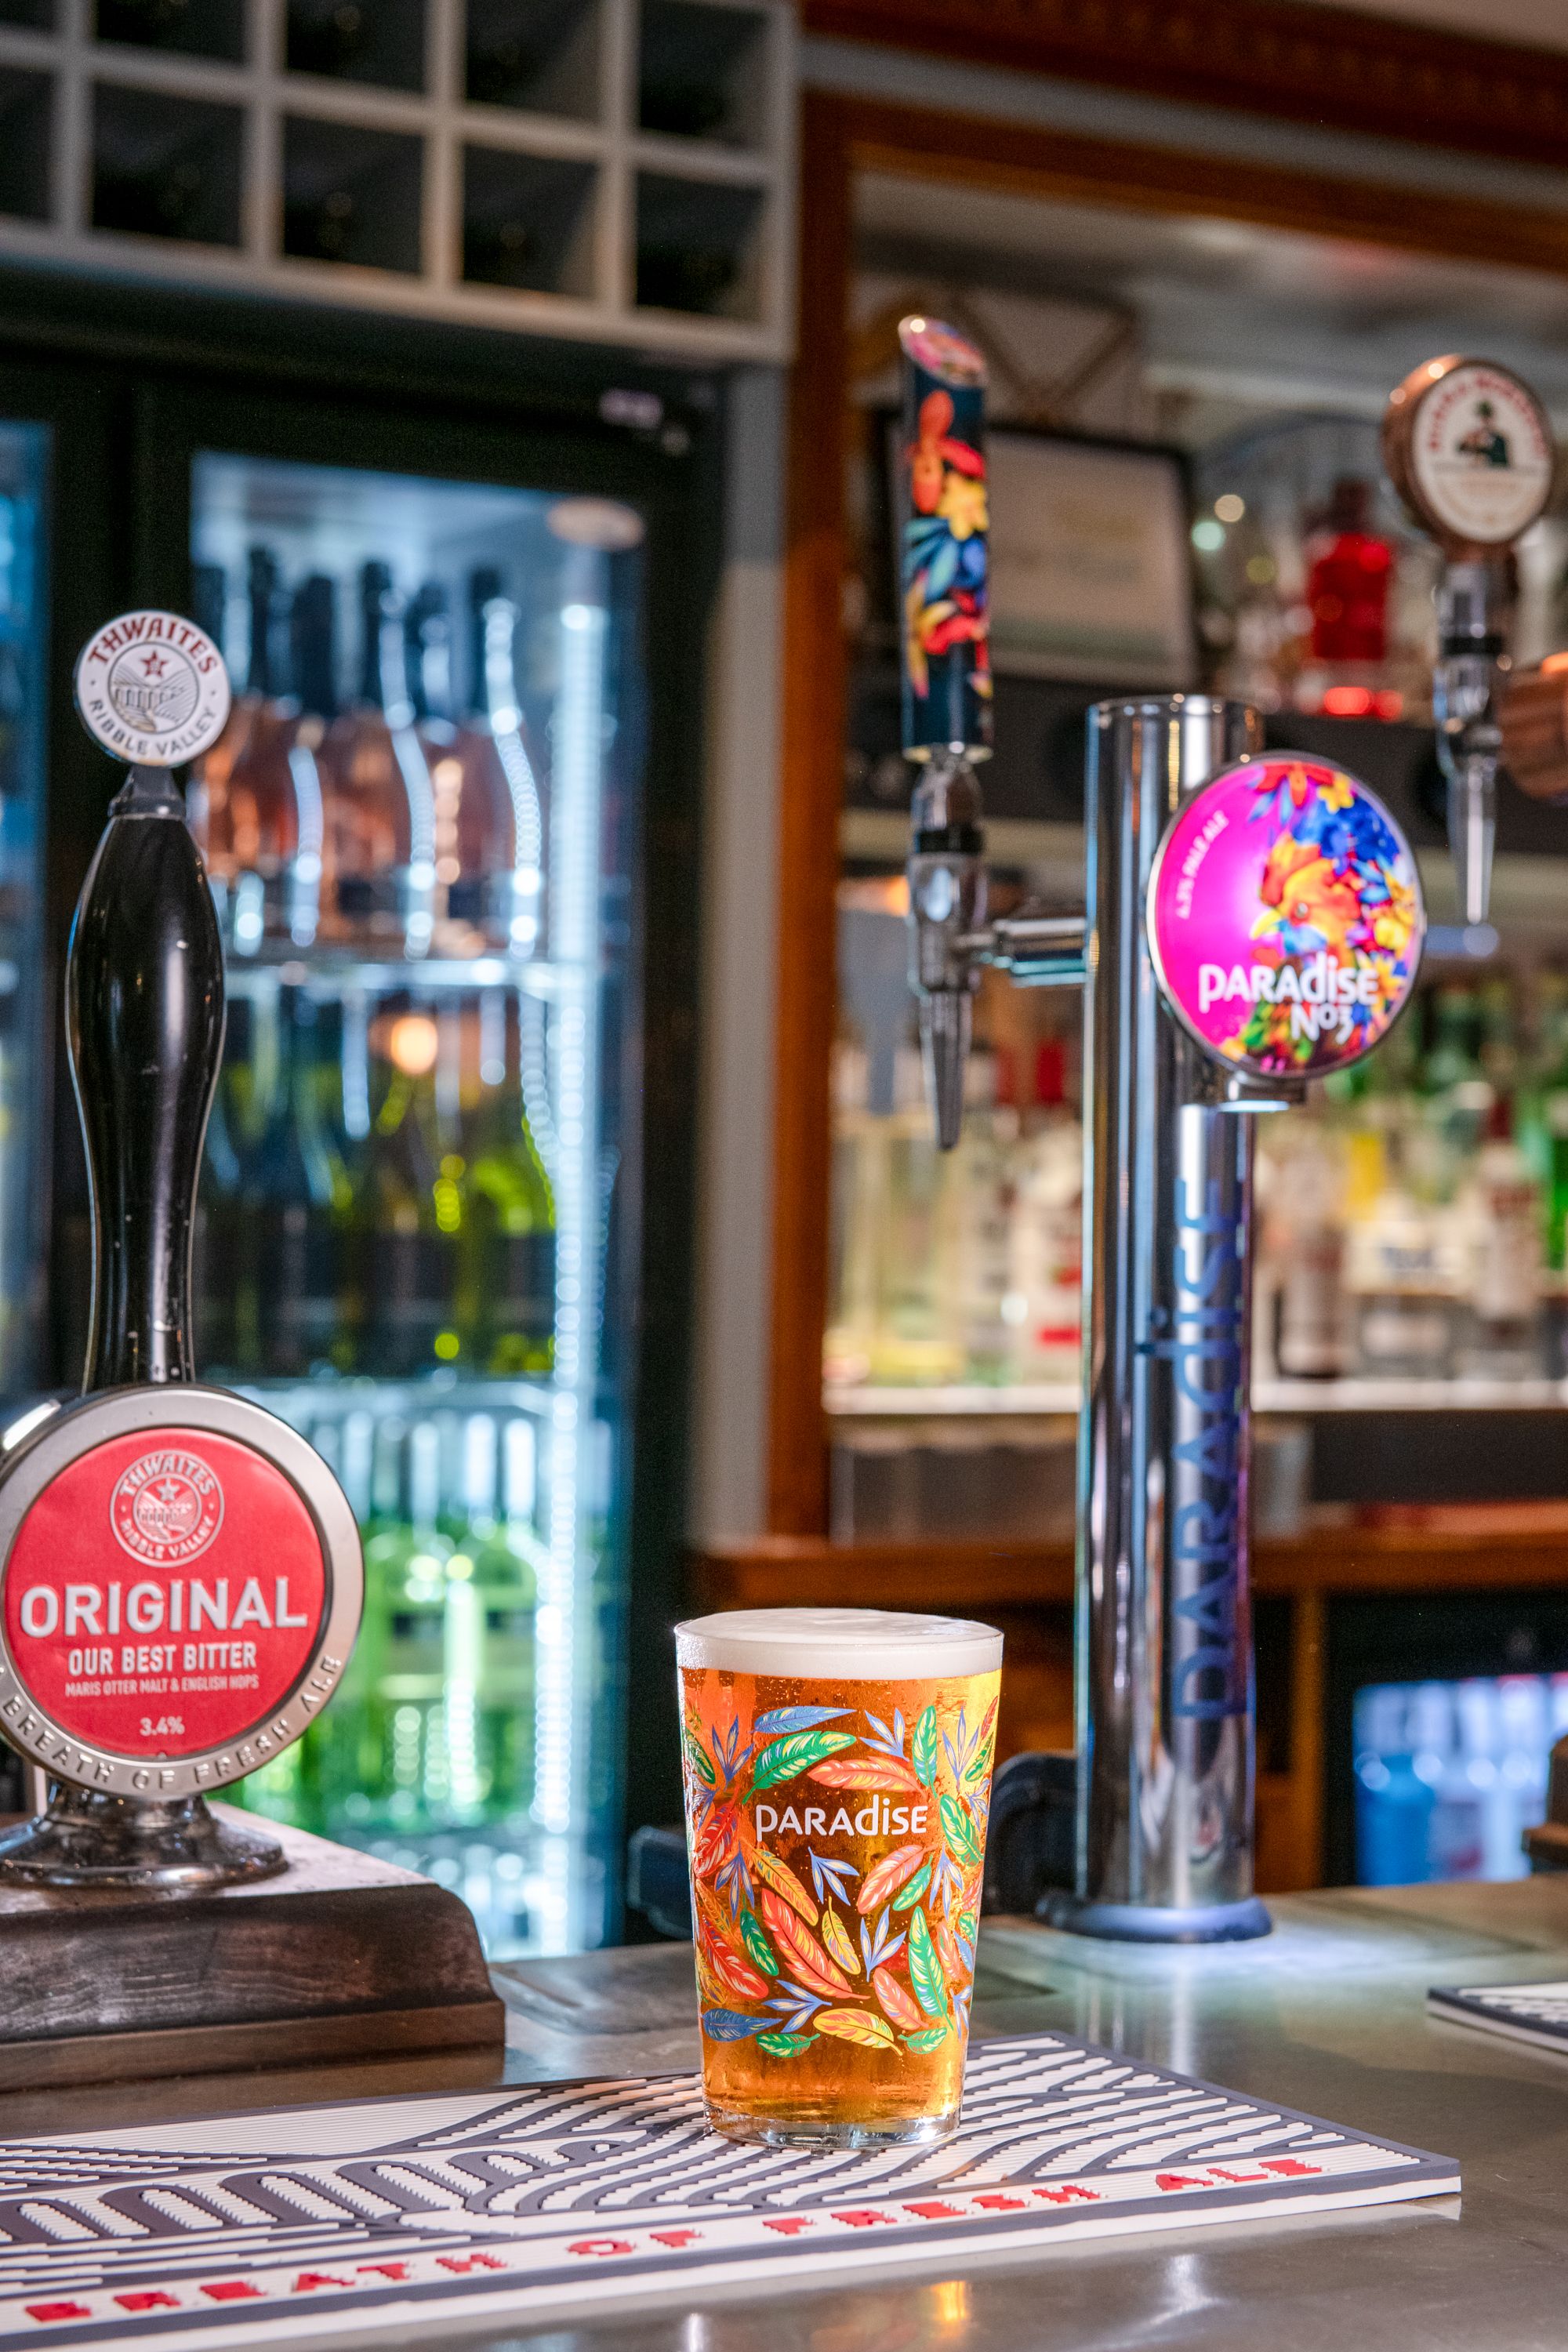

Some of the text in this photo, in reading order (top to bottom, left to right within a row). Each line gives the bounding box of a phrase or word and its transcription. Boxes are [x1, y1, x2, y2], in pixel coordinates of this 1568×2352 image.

[88, 616, 218, 674] THWAITES
[89, 699, 216, 756] RIBBLE VALLEY
[118, 1454, 216, 1497] THWAITES
[120, 1515, 214, 1560] RIBBLE VALLEY
[20, 1576, 308, 1638] ORIGINAL
[68, 1641, 257, 1676] OUR BEST BITTER
[65, 1674, 260, 1697] MARIS OTTER MALT & ENGLISH HOPS
[3, 1655, 342, 1790] BREATH OF FRESH ALE
[140, 1715, 185, 1737] 3.4%
[24, 2158, 1323, 2323] BREATH OF FRESH ALE
